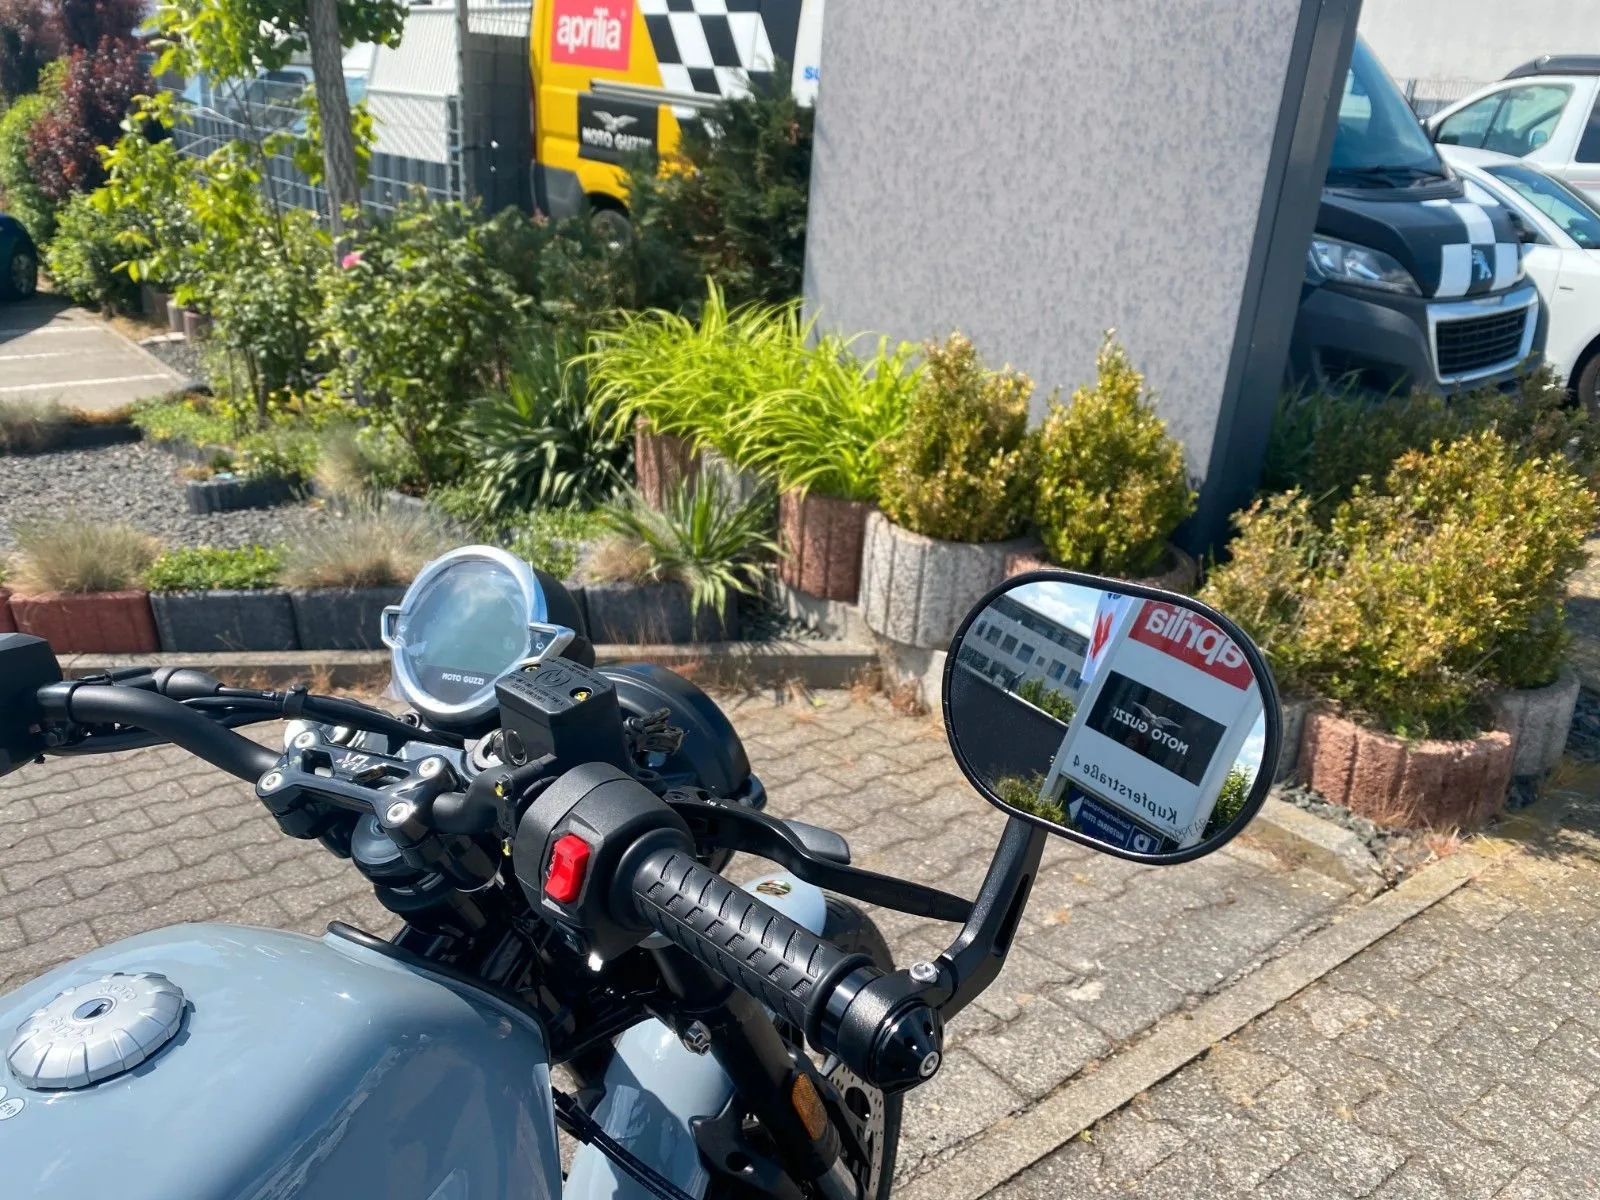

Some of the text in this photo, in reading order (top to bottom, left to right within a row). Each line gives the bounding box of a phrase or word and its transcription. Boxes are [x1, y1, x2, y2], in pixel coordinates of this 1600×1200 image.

[557, 8, 621, 53] aprilia
[582, 126, 613, 148] MOTO
[441, 672, 485, 685] MOTO GUZZI
